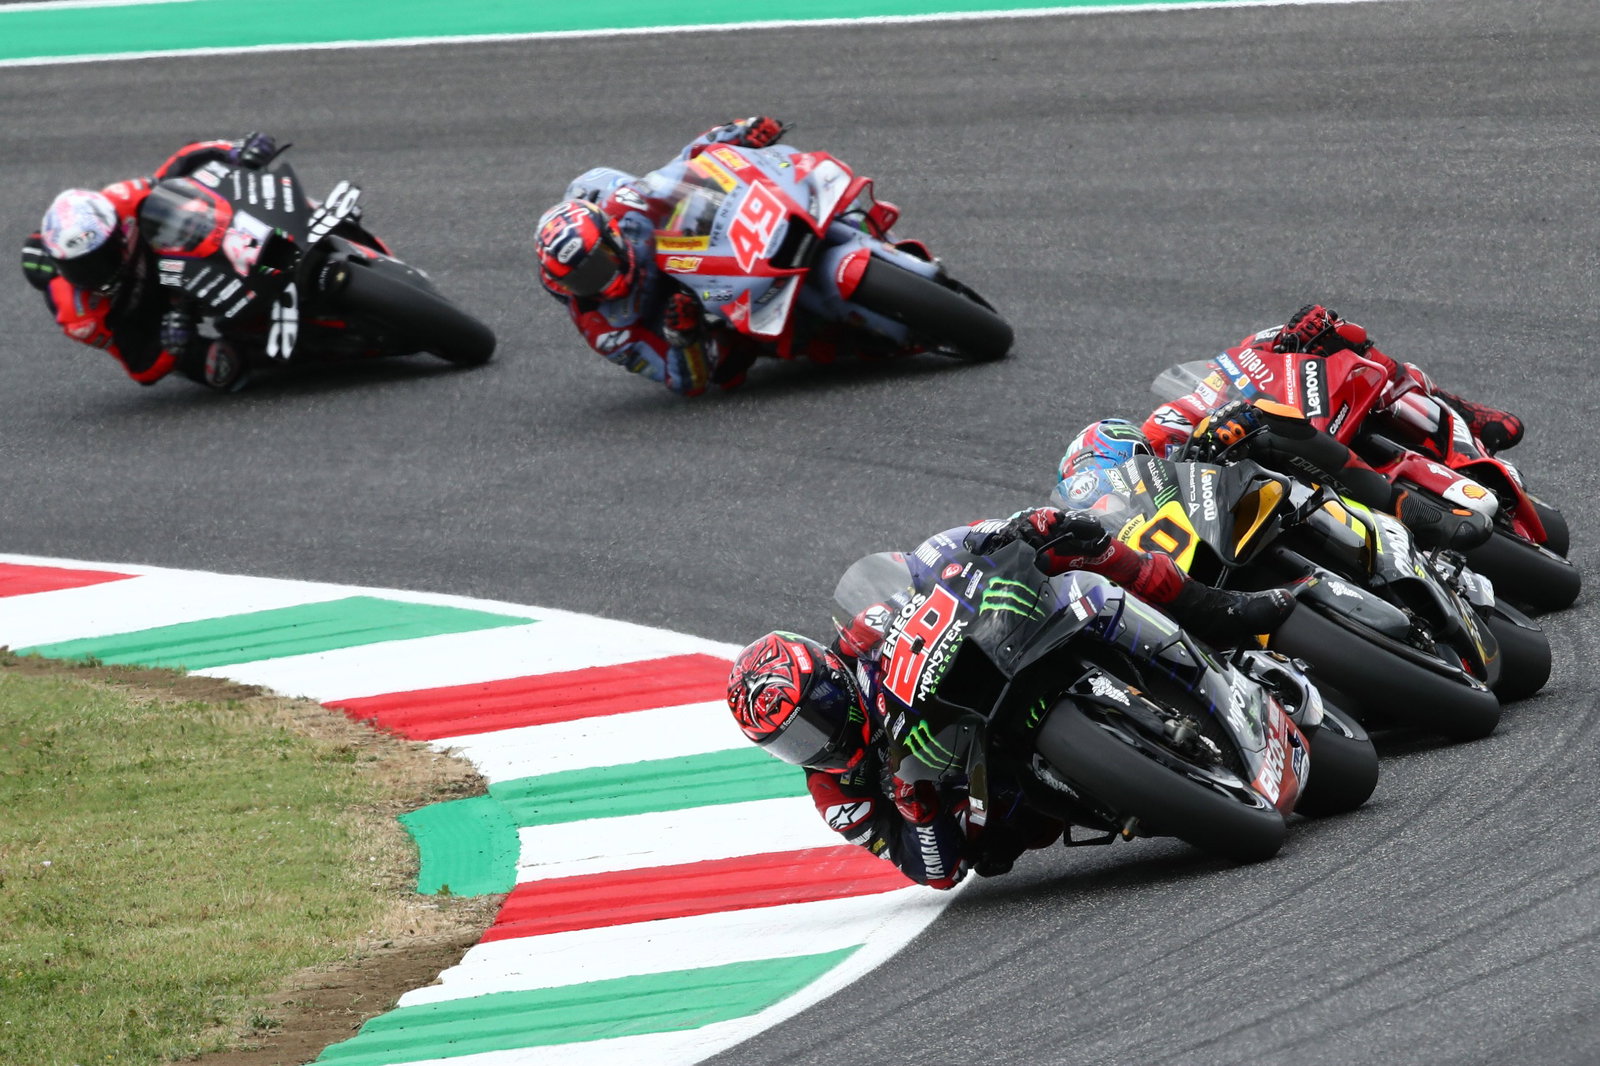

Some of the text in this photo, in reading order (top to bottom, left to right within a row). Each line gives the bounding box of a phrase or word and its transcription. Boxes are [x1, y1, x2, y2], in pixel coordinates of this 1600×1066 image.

[728, 179, 786, 273] 49
[1285, 354, 1295, 404] FRECCIAROSSA
[1305, 360, 1322, 417] Lenovo
[1072, 452, 1093, 464] Lenovo
[1147, 458, 1163, 492] MONSTER
[1200, 468, 1217, 521] mooney
[883, 593, 927, 659] ENEOS
[883, 583, 959, 707] 20
[918, 619, 969, 701] MONSTER
[930, 634, 964, 694] ENERGY
[917, 825, 945, 880] YAMAHA
